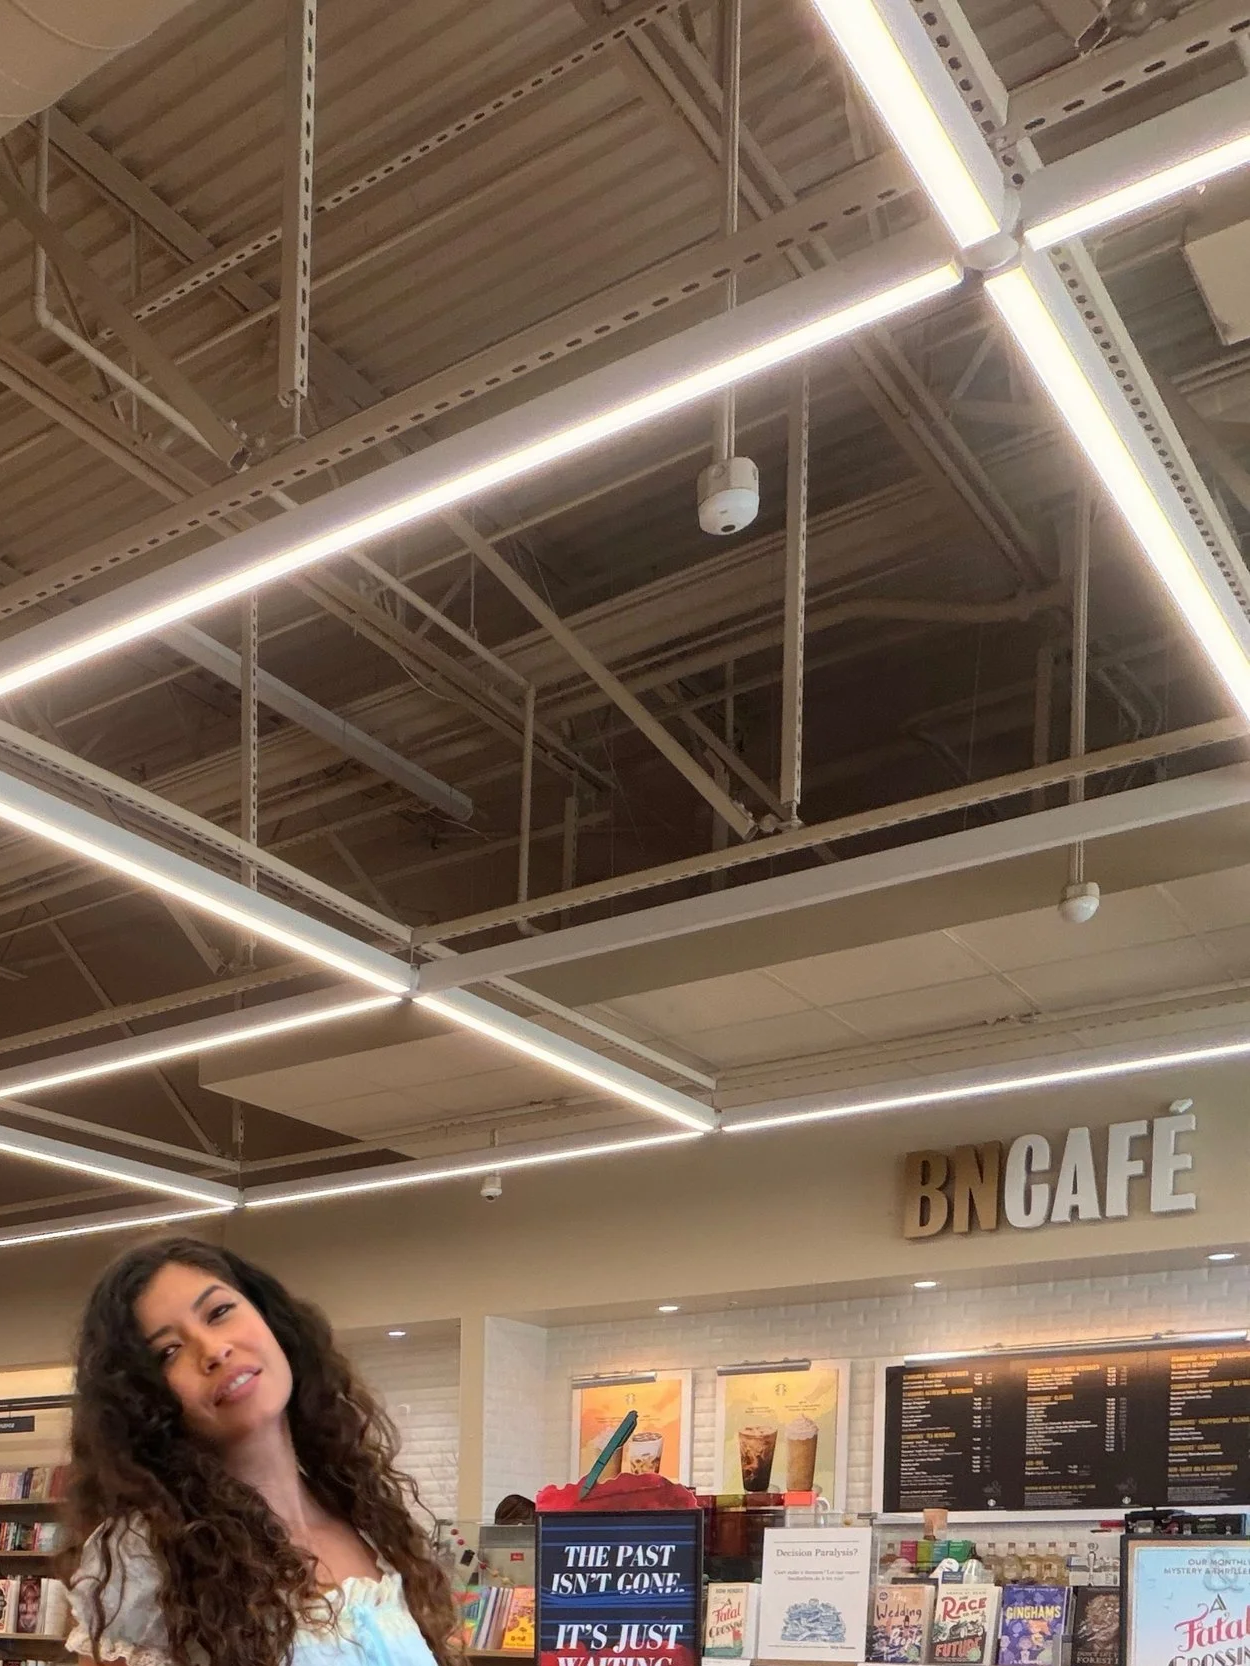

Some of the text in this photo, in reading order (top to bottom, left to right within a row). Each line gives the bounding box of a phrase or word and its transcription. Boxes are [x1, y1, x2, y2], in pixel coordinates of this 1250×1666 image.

[564, 1545, 676, 1568] THE PAST
[776, 1548, 859, 1558] Decision Paralysis?
[1163, 1567, 1202, 1575] MYSTERY
[550, 1572, 685, 1595] ISN'T GONE.
[712, 1604, 741, 1624] Fatal
[876, 1605, 922, 1621] Wedding
[942, 1597, 987, 1621] RACE
[1006, 1605, 1062, 1620] GINGHAMS
[555, 1624, 608, 1650] IT'S
[613, 1624, 684, 1653] JUST
[1076, 1657, 1111, 1665] FOREST
